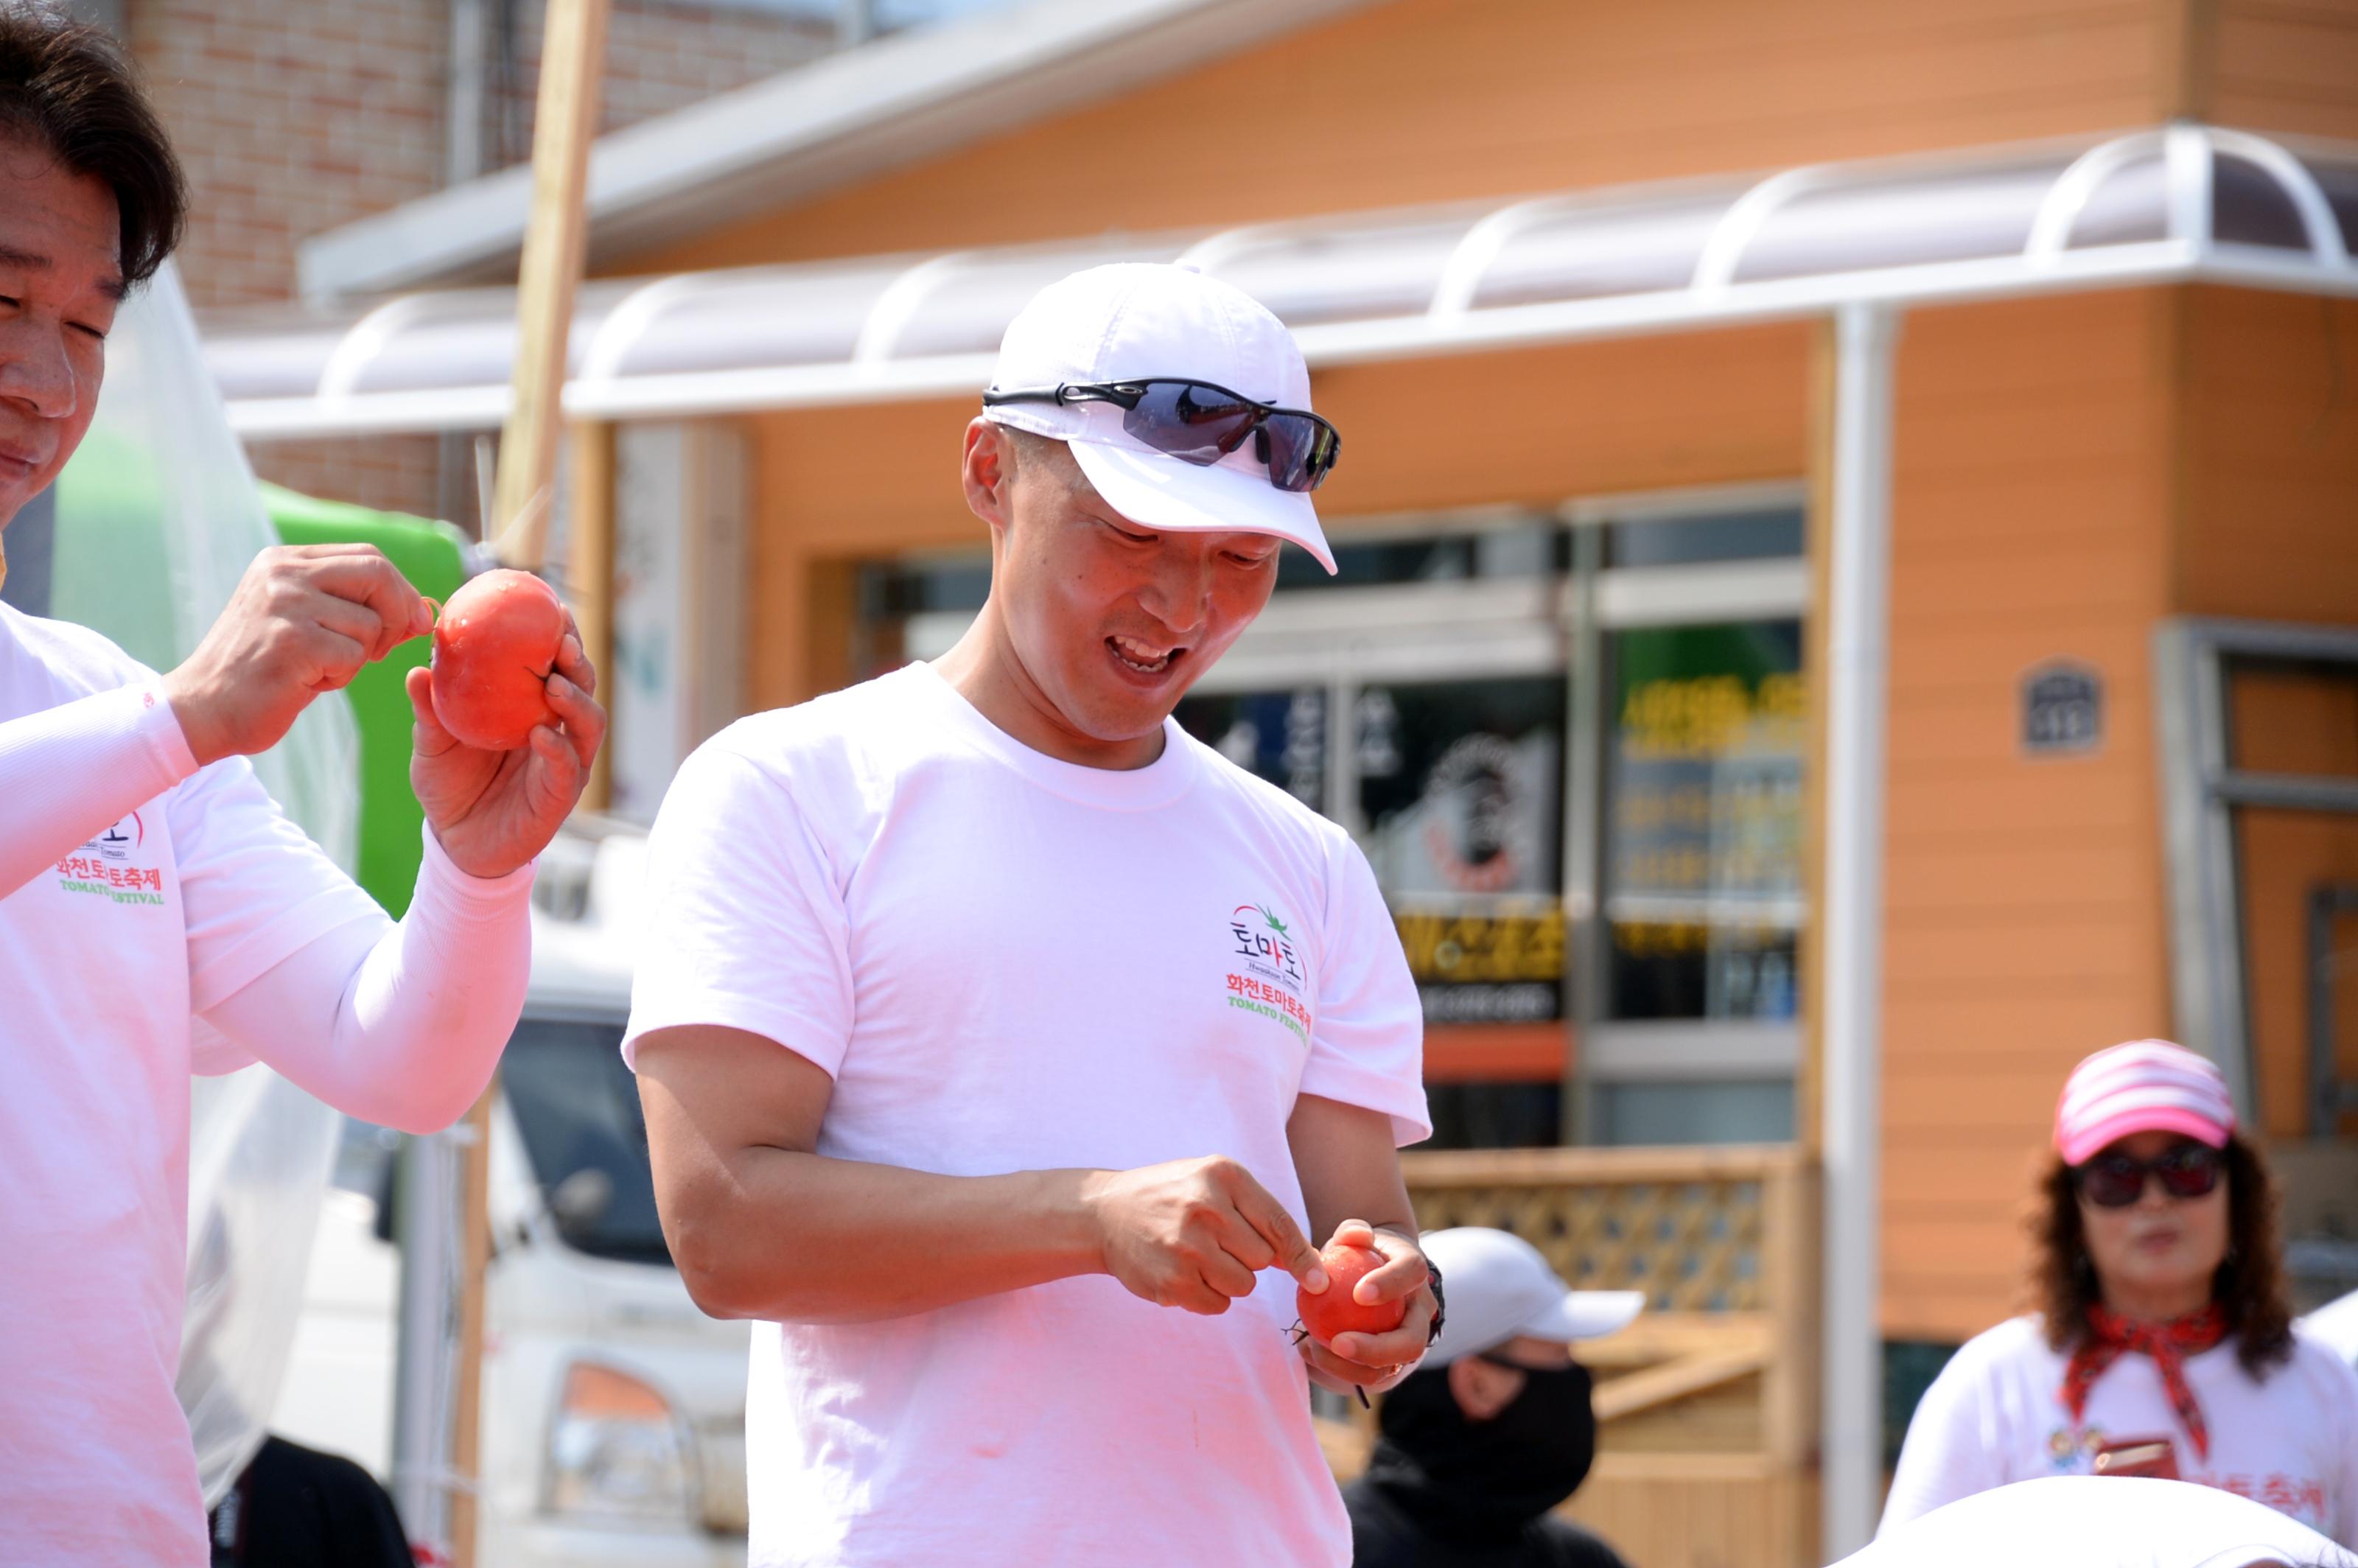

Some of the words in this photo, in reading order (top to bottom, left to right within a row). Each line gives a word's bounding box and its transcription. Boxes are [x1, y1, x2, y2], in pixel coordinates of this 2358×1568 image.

[56, 857, 161, 891] 화천토토축제
[110, 890, 164, 905] ESTIVAL
[1230, 921, 1301, 981] 토마토
[1226, 973, 1311, 1035] 화천토마토축제
[1227, 995, 1278, 1020] TOMATO
